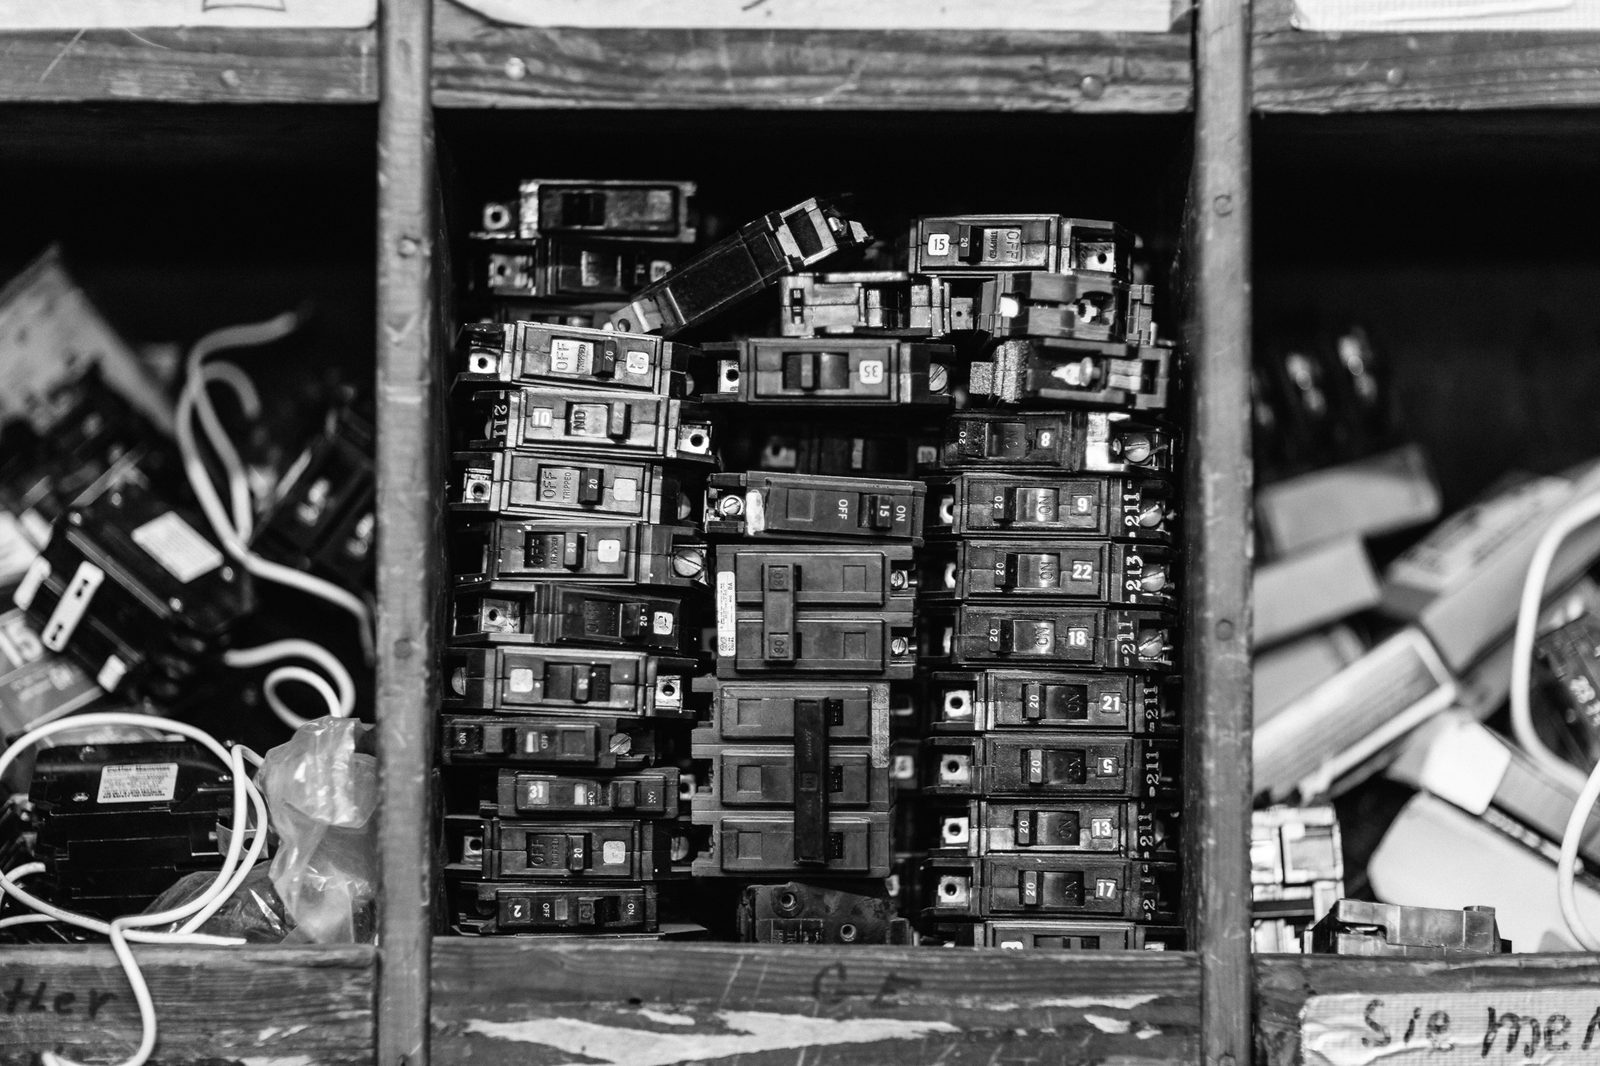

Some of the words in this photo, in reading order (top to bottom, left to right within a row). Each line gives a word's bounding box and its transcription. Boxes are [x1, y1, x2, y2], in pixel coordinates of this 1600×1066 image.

[934, 238, 945, 251] 15
[960, 237, 969, 248] 20
[1006, 230, 1019, 261] OFF
[556, 341, 569, 370] OFF
[605, 350, 614, 361] 20
[573, 410, 586, 431] ON
[959, 431, 967, 444] 20
[1041, 431, 1051, 447] 8
[543, 470, 557, 500] OFF
[563, 471, 571, 500] TRIPPED
[588, 478, 598, 490] 20
[838, 498, 848, 520] OFF
[994, 495, 1004, 509] 20
[1038, 495, 1052, 516] ON
[1078, 496, 1088, 512] 9
[880, 505, 890, 518] 15
[896, 505, 906, 522] ON
[567, 541, 577, 553] 20
[995, 562, 1005, 576] 20
[1040, 561, 1054, 580] ON
[1073, 563, 1093, 579] 22
[640, 615, 648, 627] 20
[990, 629, 999, 642] 20
[1036, 627, 1049, 646] ON
[1068, 631, 1086, 646] 18
[1030, 694, 1039, 709] 20
[1103, 694, 1120, 711] 21
[541, 734, 549, 749] OFF
[1031, 760, 1040, 774] 20
[1103, 759, 1113, 773] 5
[529, 784, 544, 798] 31
[1020, 820, 1029, 834] 20
[1094, 822, 1111, 836] 13
[531, 839, 544, 866] OFF
[573, 847, 583, 859] 20
[1026, 882, 1036, 897] 20
[1098, 882, 1116, 898] 17
[542, 903, 550, 918] OFF
[627, 902, 635, 916] ON
